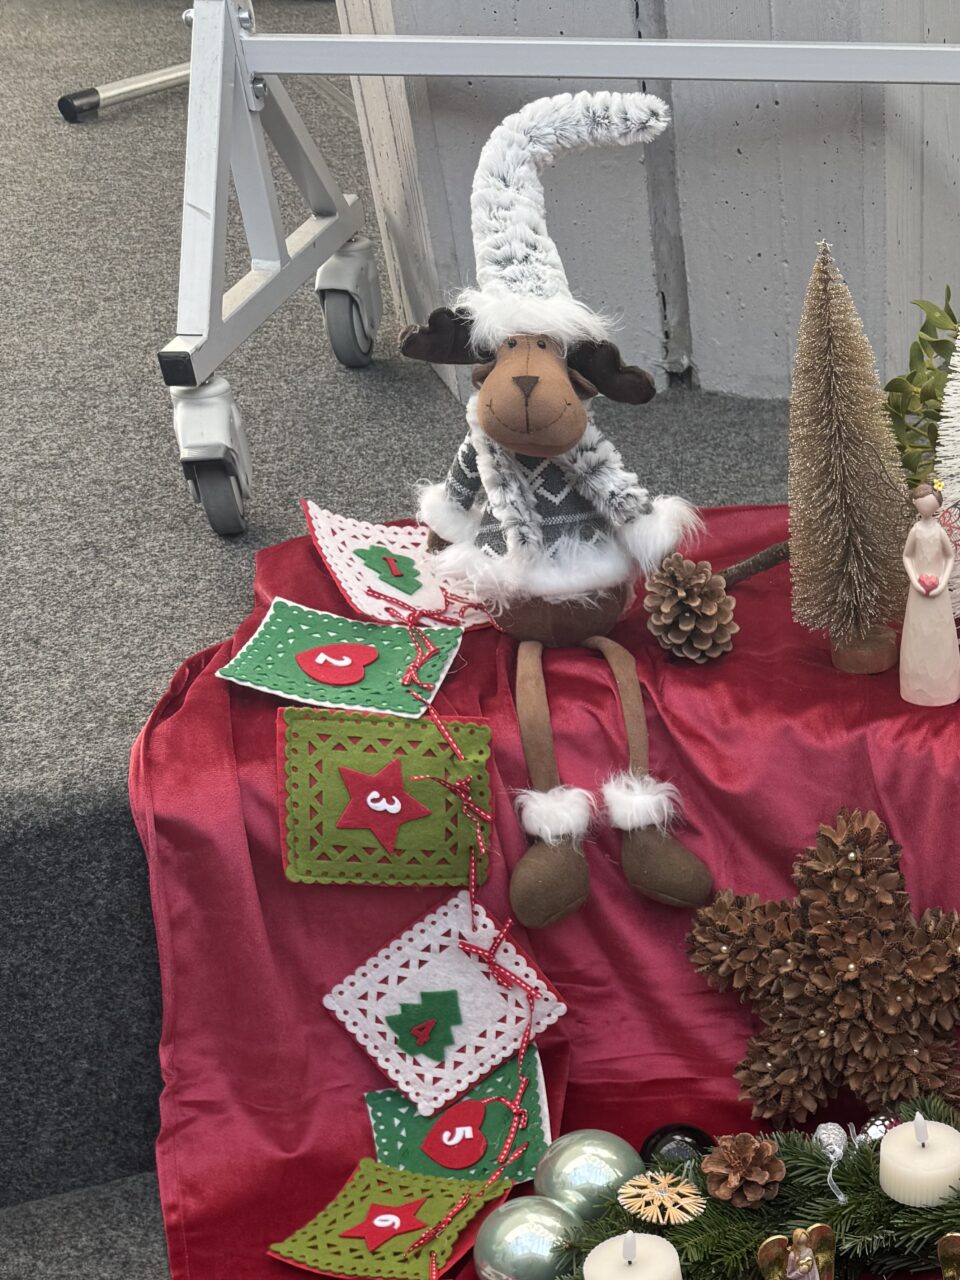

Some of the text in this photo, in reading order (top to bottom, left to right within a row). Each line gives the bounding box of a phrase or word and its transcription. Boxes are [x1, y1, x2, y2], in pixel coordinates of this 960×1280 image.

[382, 556, 404, 577] 1
[314, 652, 353, 668] 2
[366, 790, 402, 815] 3
[410, 1018, 437, 1046] 4
[441, 1125, 474, 1146] 5
[372, 1214, 401, 1230] 6
